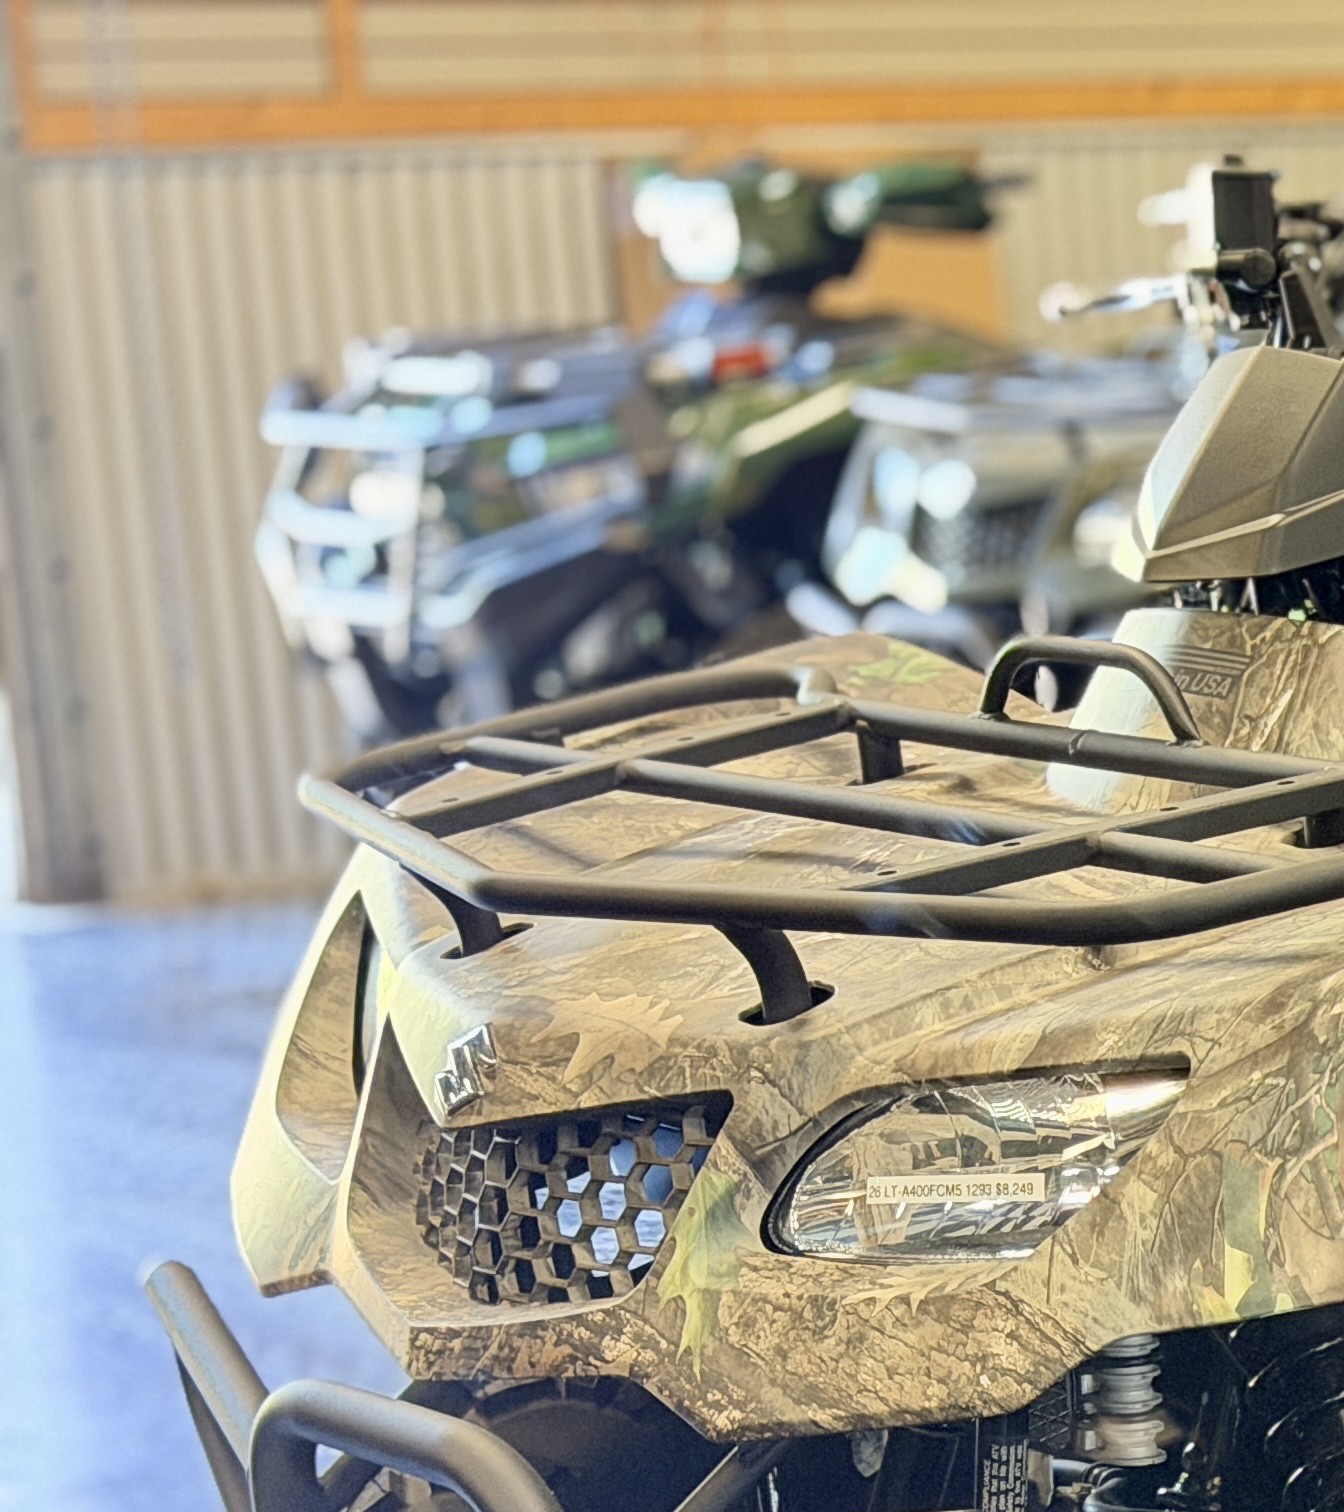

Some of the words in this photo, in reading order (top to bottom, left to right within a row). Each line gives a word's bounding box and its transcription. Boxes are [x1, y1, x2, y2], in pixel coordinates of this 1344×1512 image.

[1191, 672, 1232, 696] USA
[868, 1186, 882, 1199] 26
[884, 1183, 962, 1198] LT-A400FCM5
[966, 1183, 992, 1197] 1293
[995, 1181, 1034, 1198] $8,249
